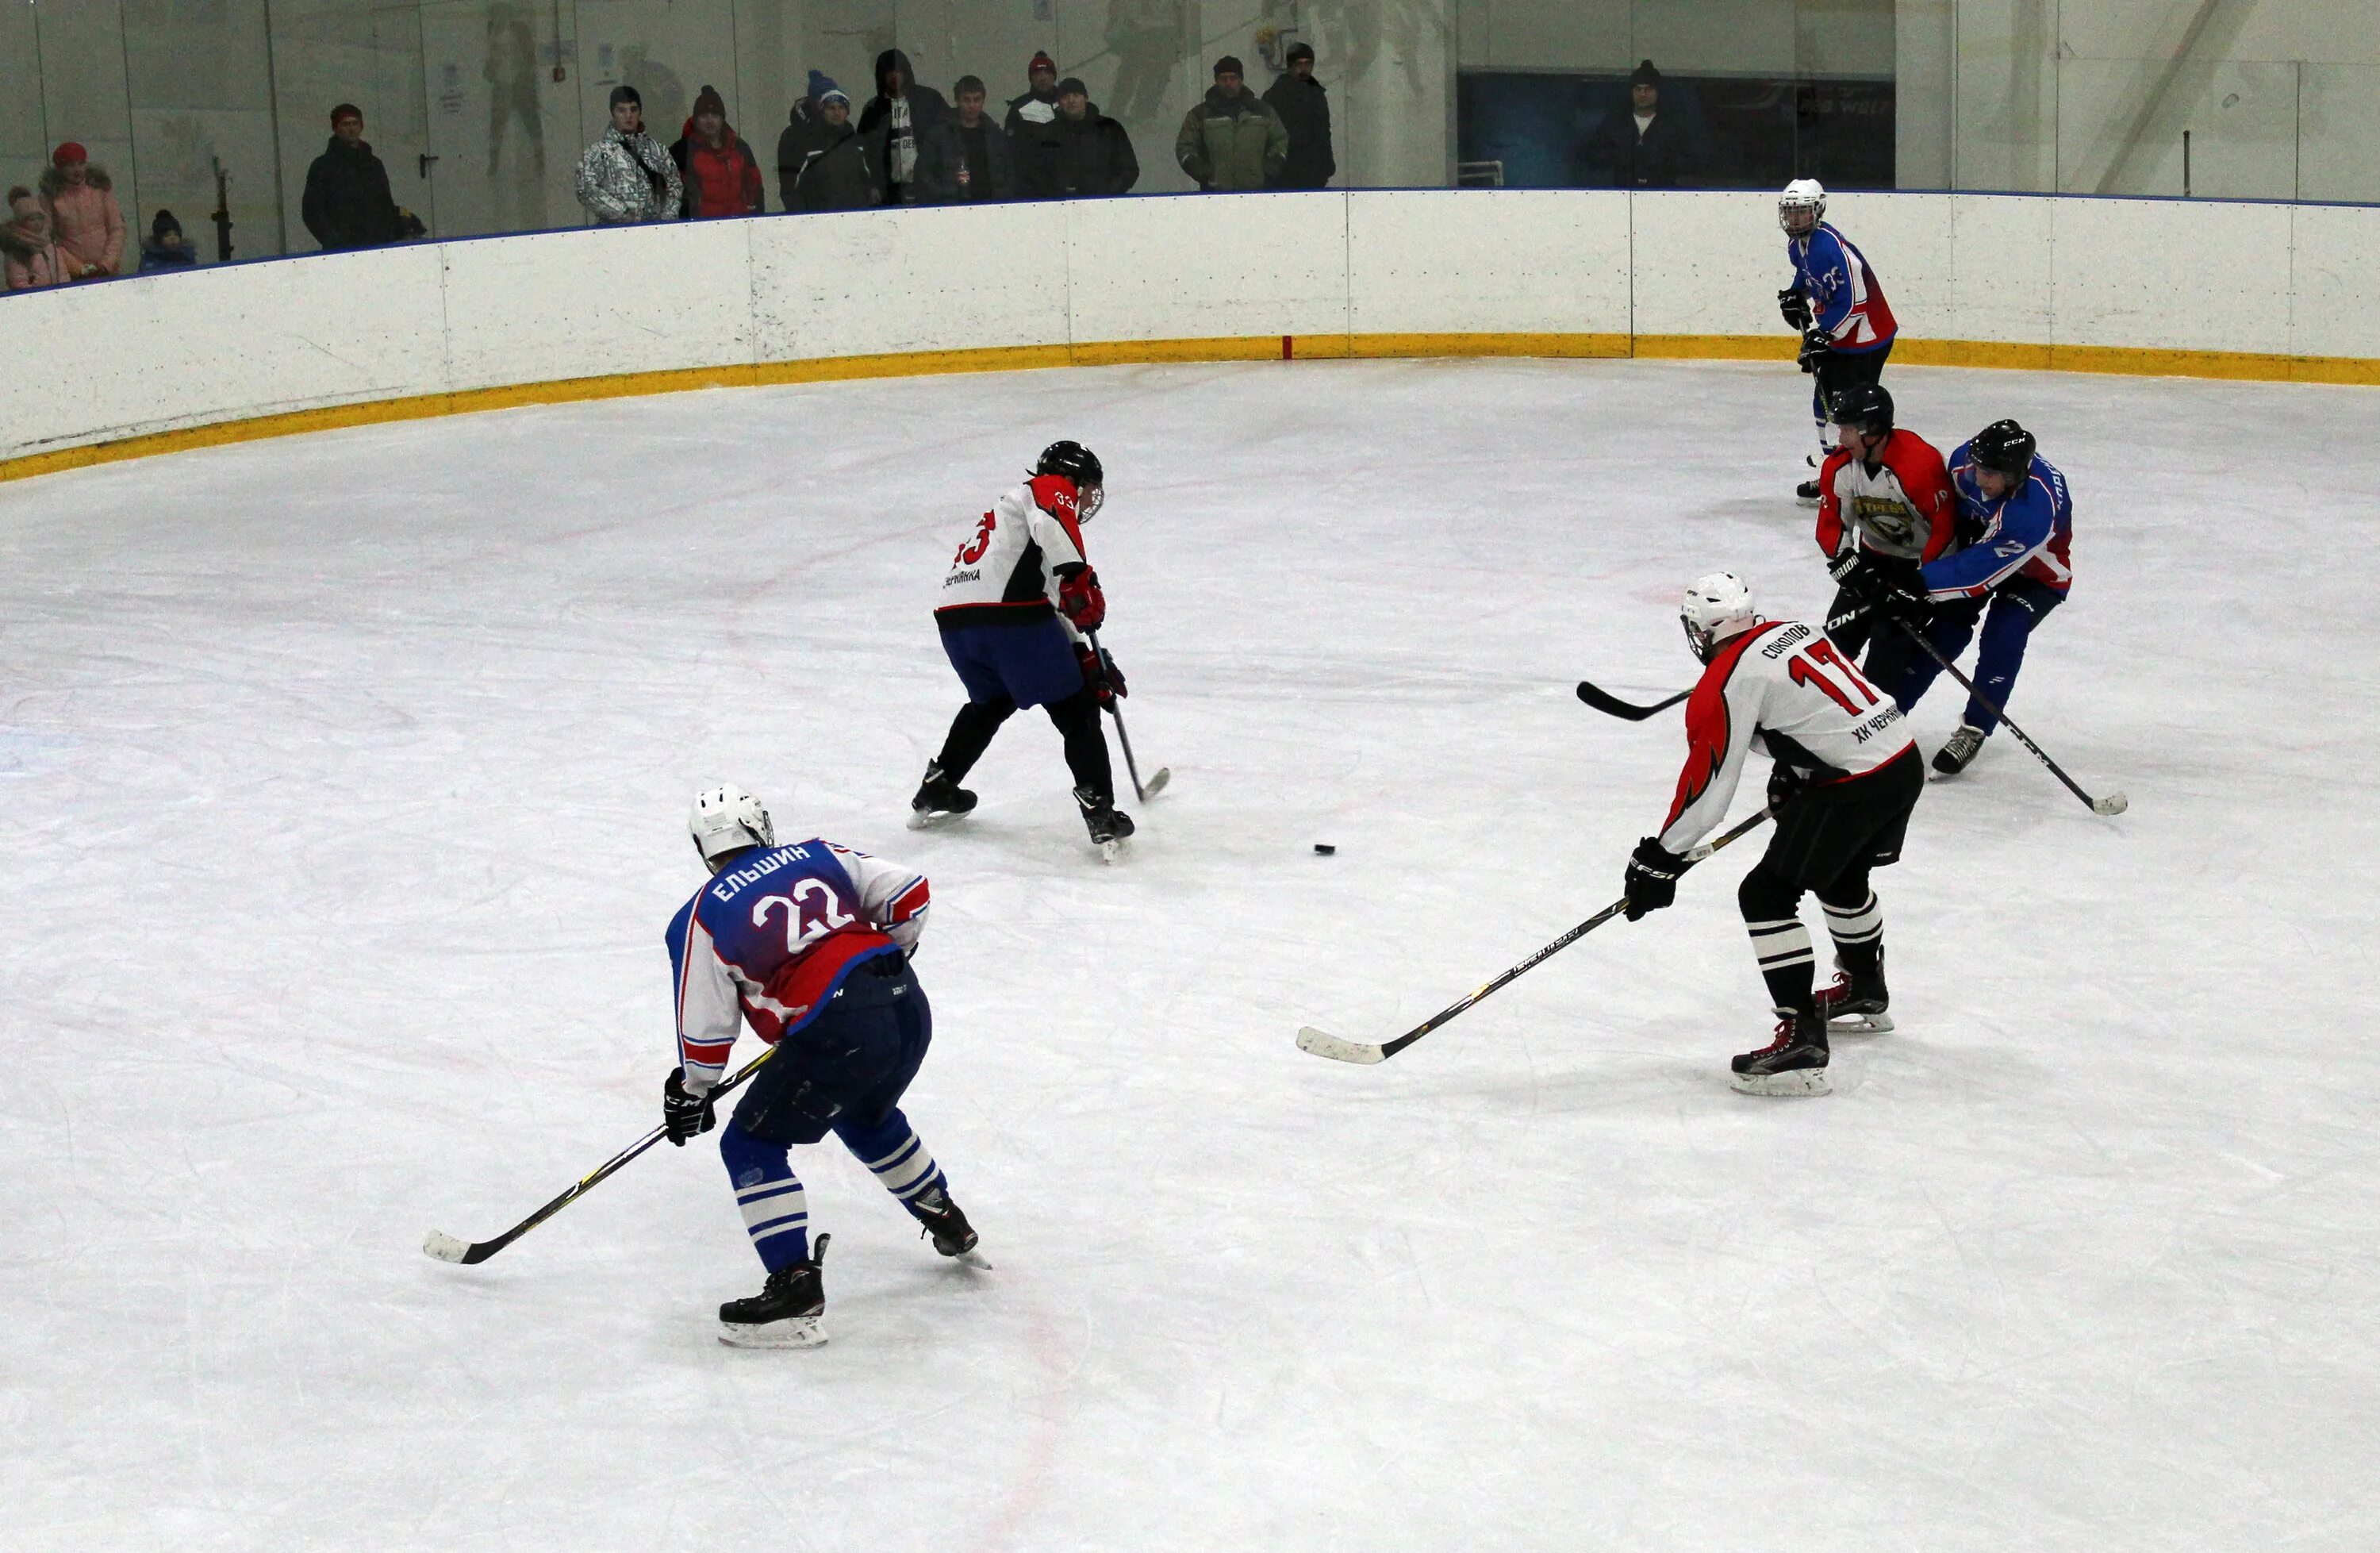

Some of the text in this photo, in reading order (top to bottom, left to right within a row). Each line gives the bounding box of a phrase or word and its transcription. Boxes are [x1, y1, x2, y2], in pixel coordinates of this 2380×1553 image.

[2004, 437, 2025, 447] CCM
[1055, 492, 1074, 509] 33
[1762, 624, 1810, 659] СОКОЛОВ
[1788, 637, 1879, 717] 17
[1852, 724, 1872, 744] ХК
[712, 847, 811, 901] ЕЛЬШИН
[1630, 856, 1675, 879] EFSI
[752, 878, 855, 955] 22
